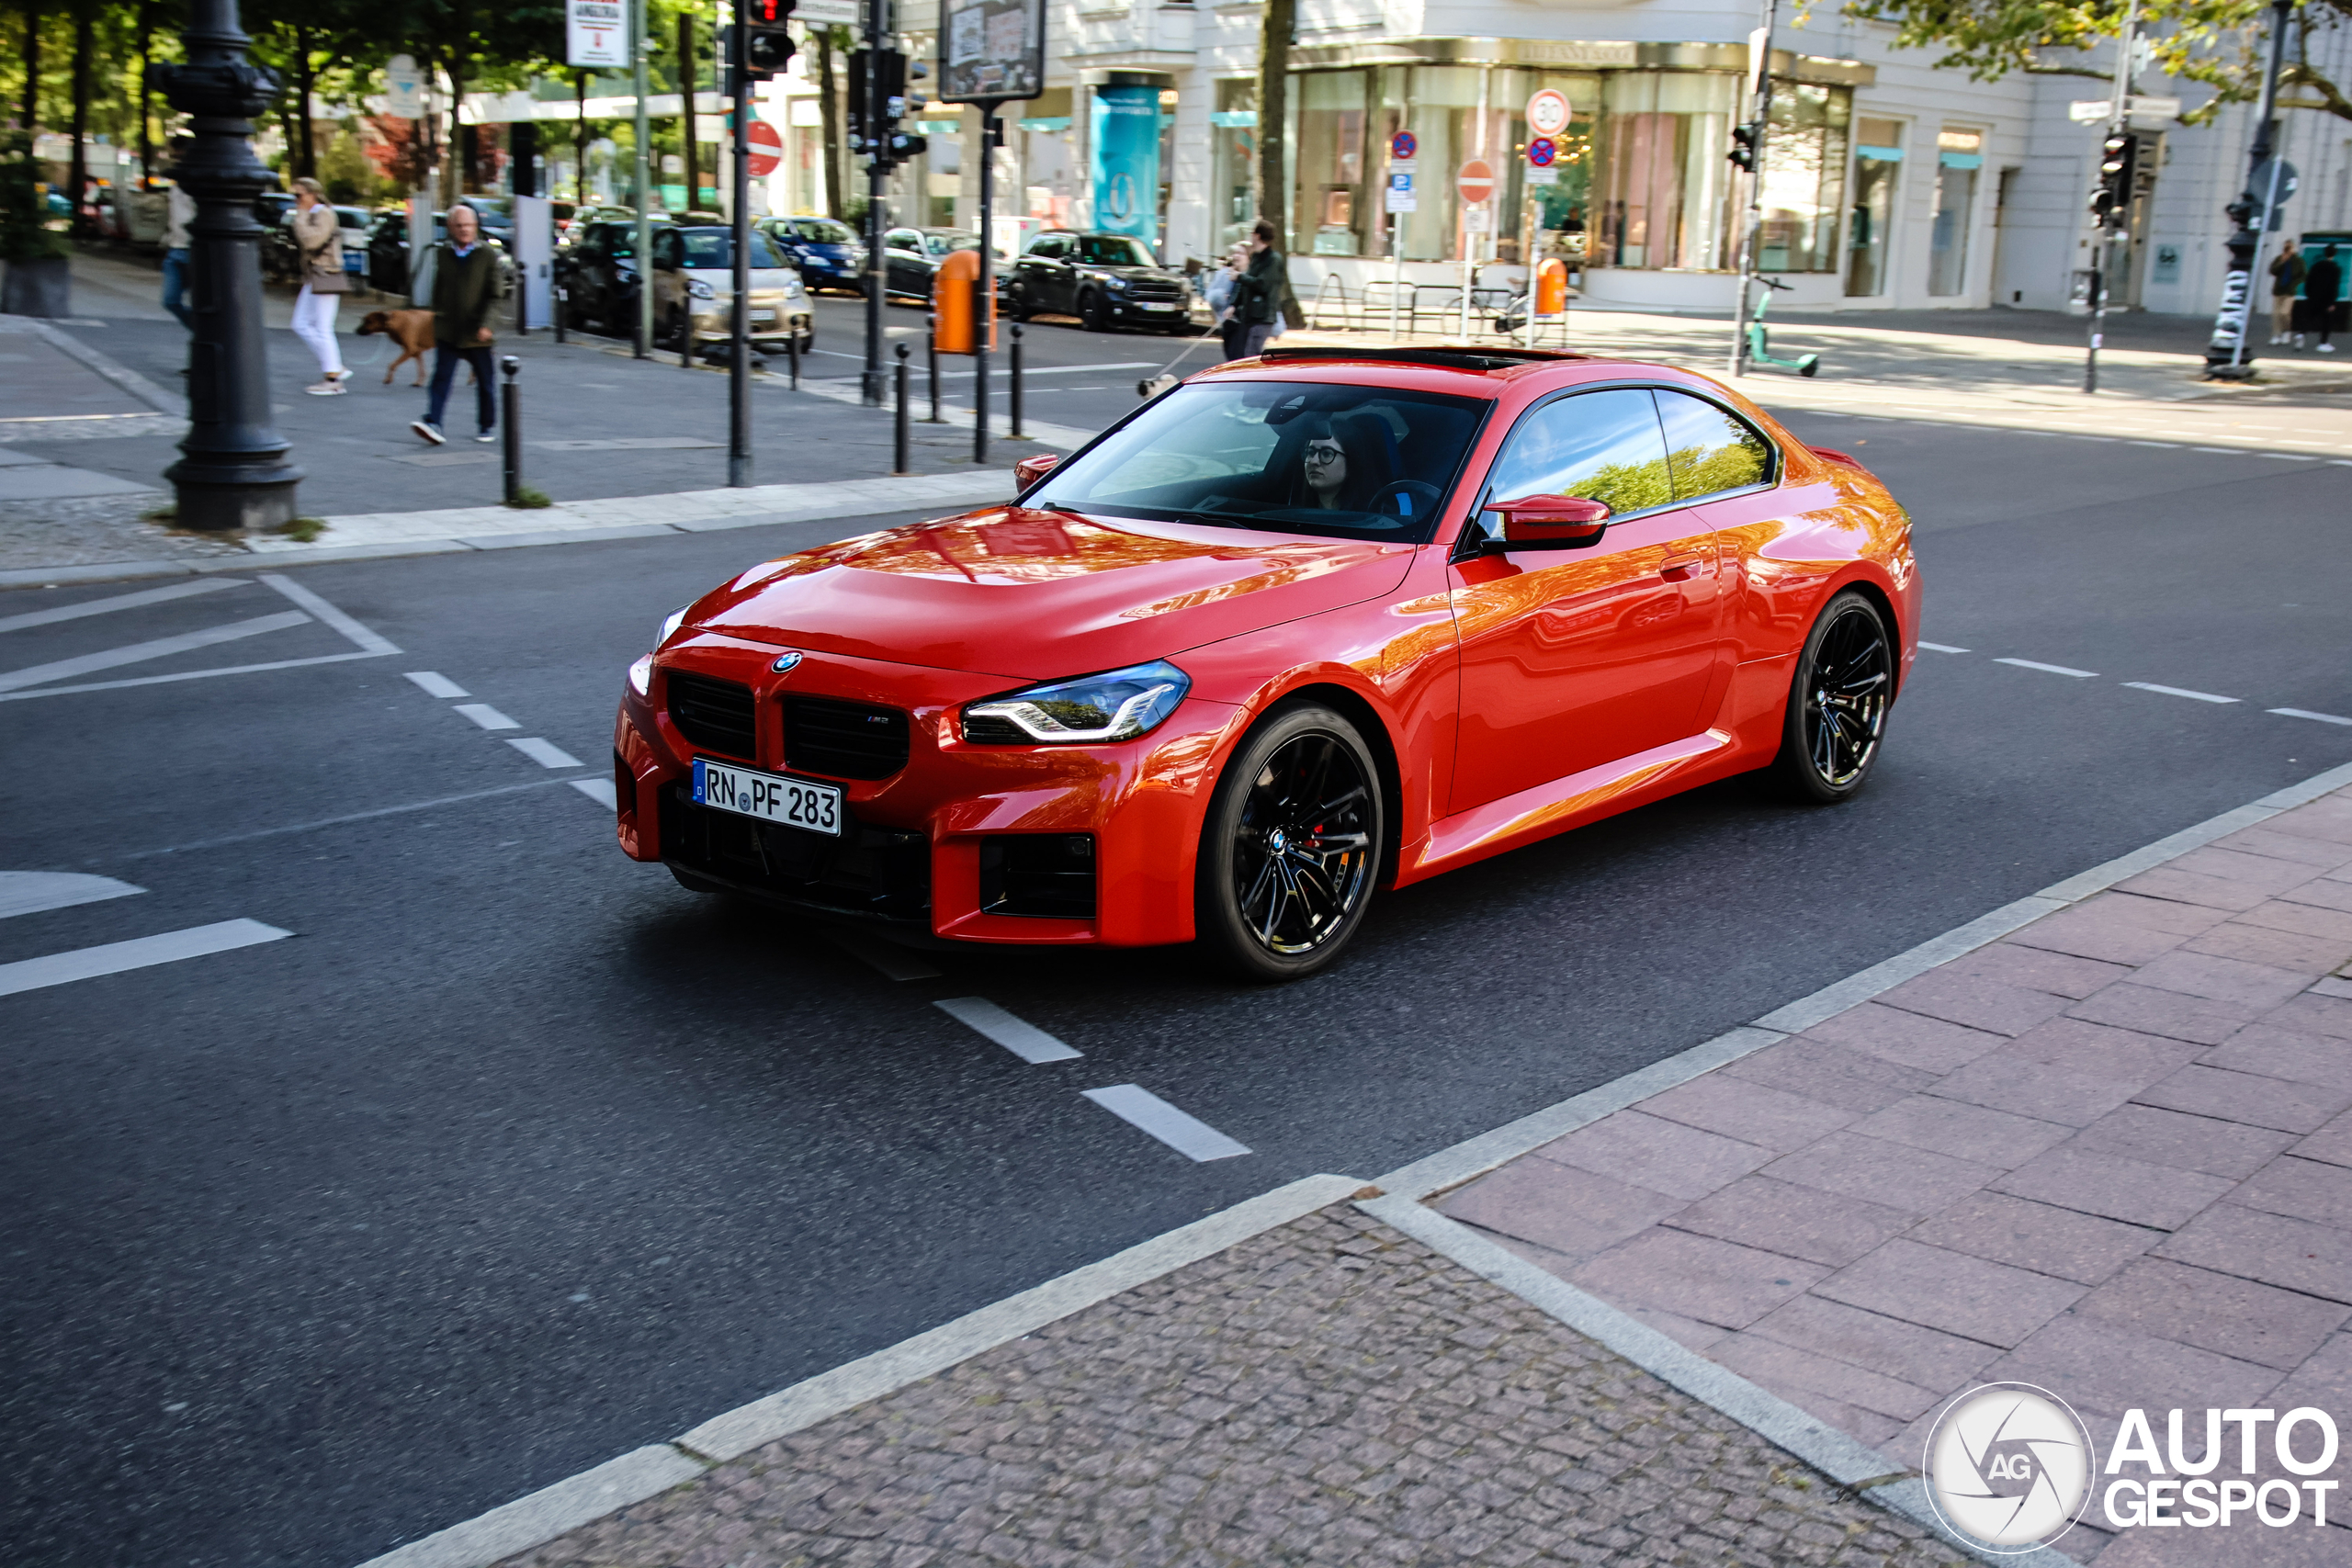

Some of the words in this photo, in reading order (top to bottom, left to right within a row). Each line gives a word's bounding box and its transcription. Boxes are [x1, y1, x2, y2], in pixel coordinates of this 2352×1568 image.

[1539, 102, 1559, 122] 30
[696, 785, 703, 796] D
[707, 769, 736, 807] RN
[752, 779, 782, 816] PF
[788, 786, 835, 828] 283
